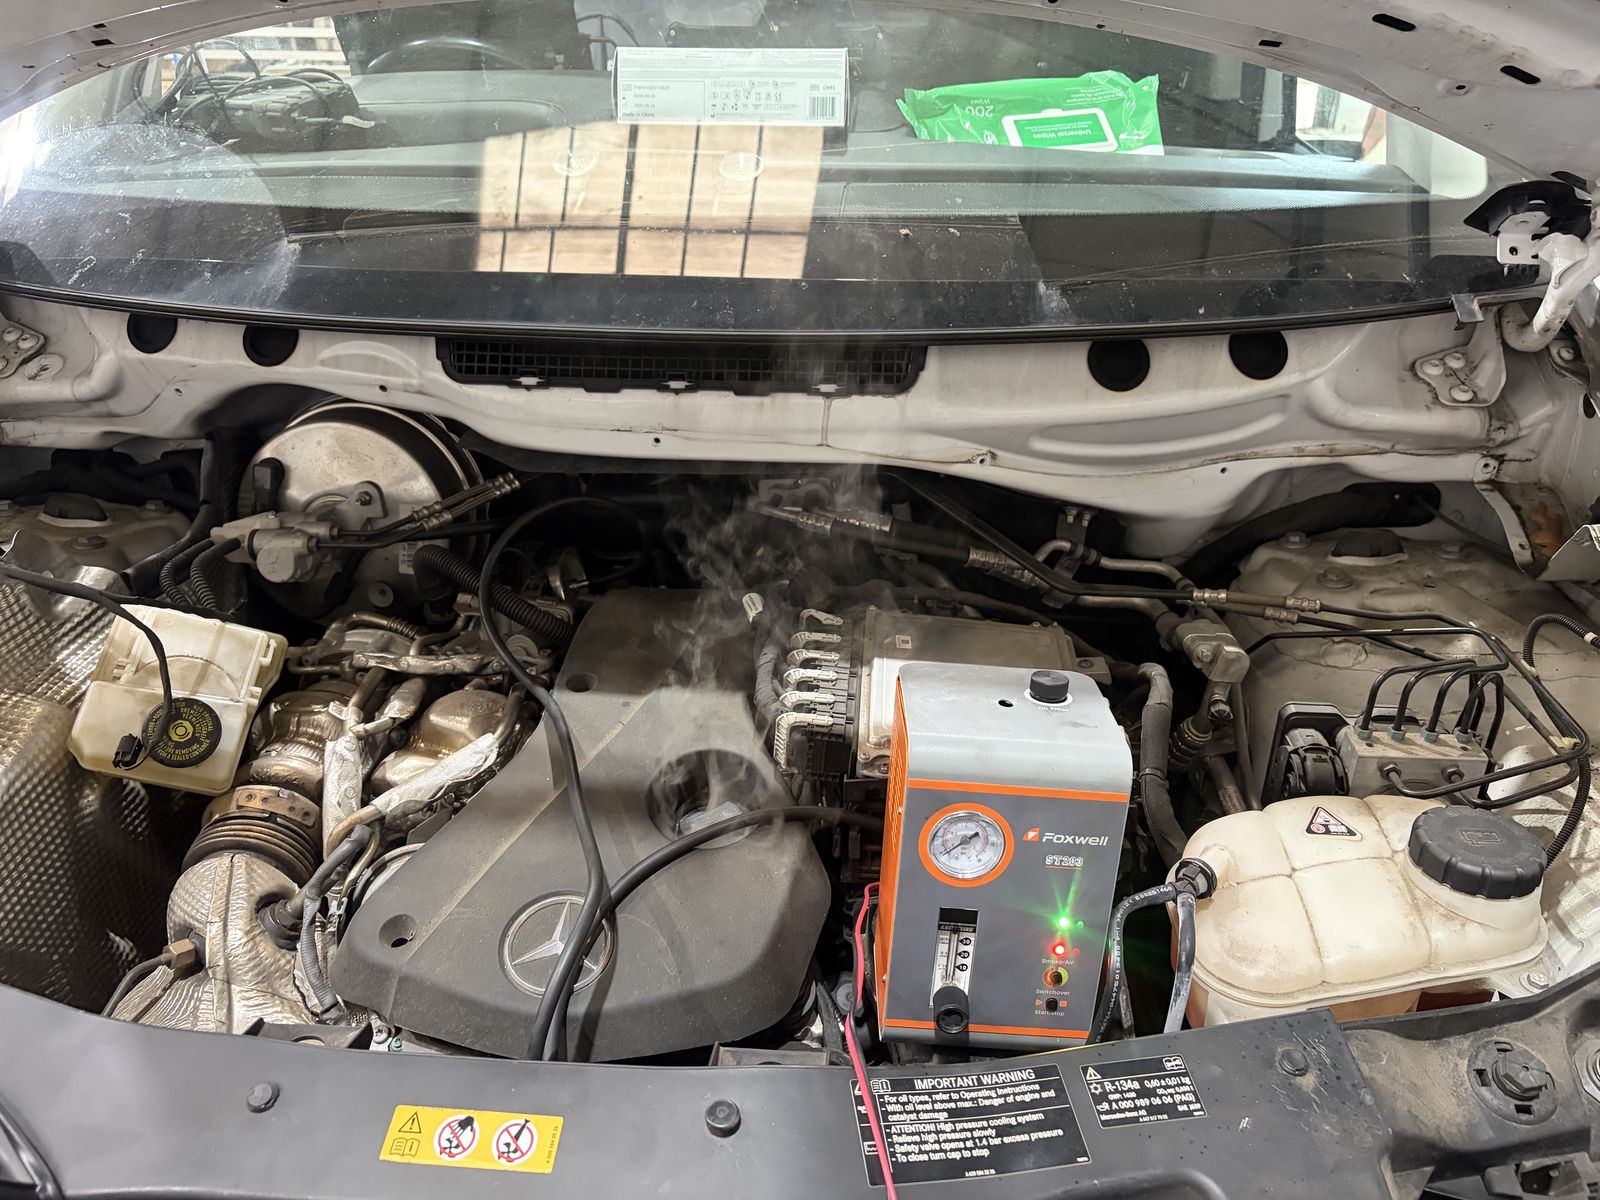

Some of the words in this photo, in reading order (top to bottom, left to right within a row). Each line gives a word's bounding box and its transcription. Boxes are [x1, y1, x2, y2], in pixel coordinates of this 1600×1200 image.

[1032, 132, 1057, 140] Wipes
[1057, 129, 1092, 138] Universal
[1045, 854, 1084, 867] ST203
[1035, 988, 1071, 996] Switchover
[914, 1076, 978, 1090] IMPORTANT
[980, 1069, 1036, 1085] WARNING
[1103, 1079, 1141, 1093] R-134a
[1144, 1078, 1160, 1089] 0,60
[1166, 1076, 1181, 1087] 0,01
[1181, 1076, 1192, 1085] kg
[884, 1095, 897, 1103] For
[898, 1094, 907, 1103] oil
[932, 1093, 950, 1101] refer
[951, 1092, 959, 1100] to
[960, 1089, 997, 1099] Operating
[997, 1083, 1040, 1096] Instructions
[886, 1103, 904, 1113] With
[904, 1103, 914, 1111] oil
[915, 1102, 932, 1111] level
[934, 1101, 956, 1110] above
[978, 1097, 1005, 1106] Danger
[1006, 1095, 1015, 1103] of
[1015, 1092, 1040, 1102] engine
[1041, 1088, 1056, 1098] and
[1112, 1101, 1119, 1110] A
[1119, 1099, 1134, 1109] 000
[1135, 1097, 1150, 1107] 989
[1150, 1096, 1162, 1106] 06
[1162, 1095, 1174, 1104] 06
[1173, 1092, 1196, 1104] (PAG)
[887, 1112, 918, 1122] catalyst
[918, 1111, 949, 1120] damage
[891, 1123, 936, 1134] ATTENTION!
[937, 1122, 955, 1132] High
[956, 1120, 988, 1131] pressure
[989, 1116, 1017, 1126] cooling
[1017, 1112, 1045, 1124] system
[892, 1134, 920, 1144] Relieve
[921, 1133, 938, 1143] high
[939, 1131, 972, 1141] pressure
[972, 1128, 996, 1137] slowly
[894, 1143, 920, 1153] Safety
[920, 1142, 940, 1151] valve
[941, 1141, 965, 1151] opens
[965, 1140, 974, 1148] at
[975, 1138, 988, 1147] 1.4
[988, 1136, 1002, 1146] bar
[1003, 1133, 1030, 1144] excess
[1030, 1128, 1064, 1141] pressure
[896, 1153, 907, 1163] To
[908, 1152, 929, 1162] close
[929, 1151, 946, 1160] turn
[946, 1150, 962, 1160] cap
[962, 1149, 971, 1158] to
[971, 1148, 990, 1158] stop
